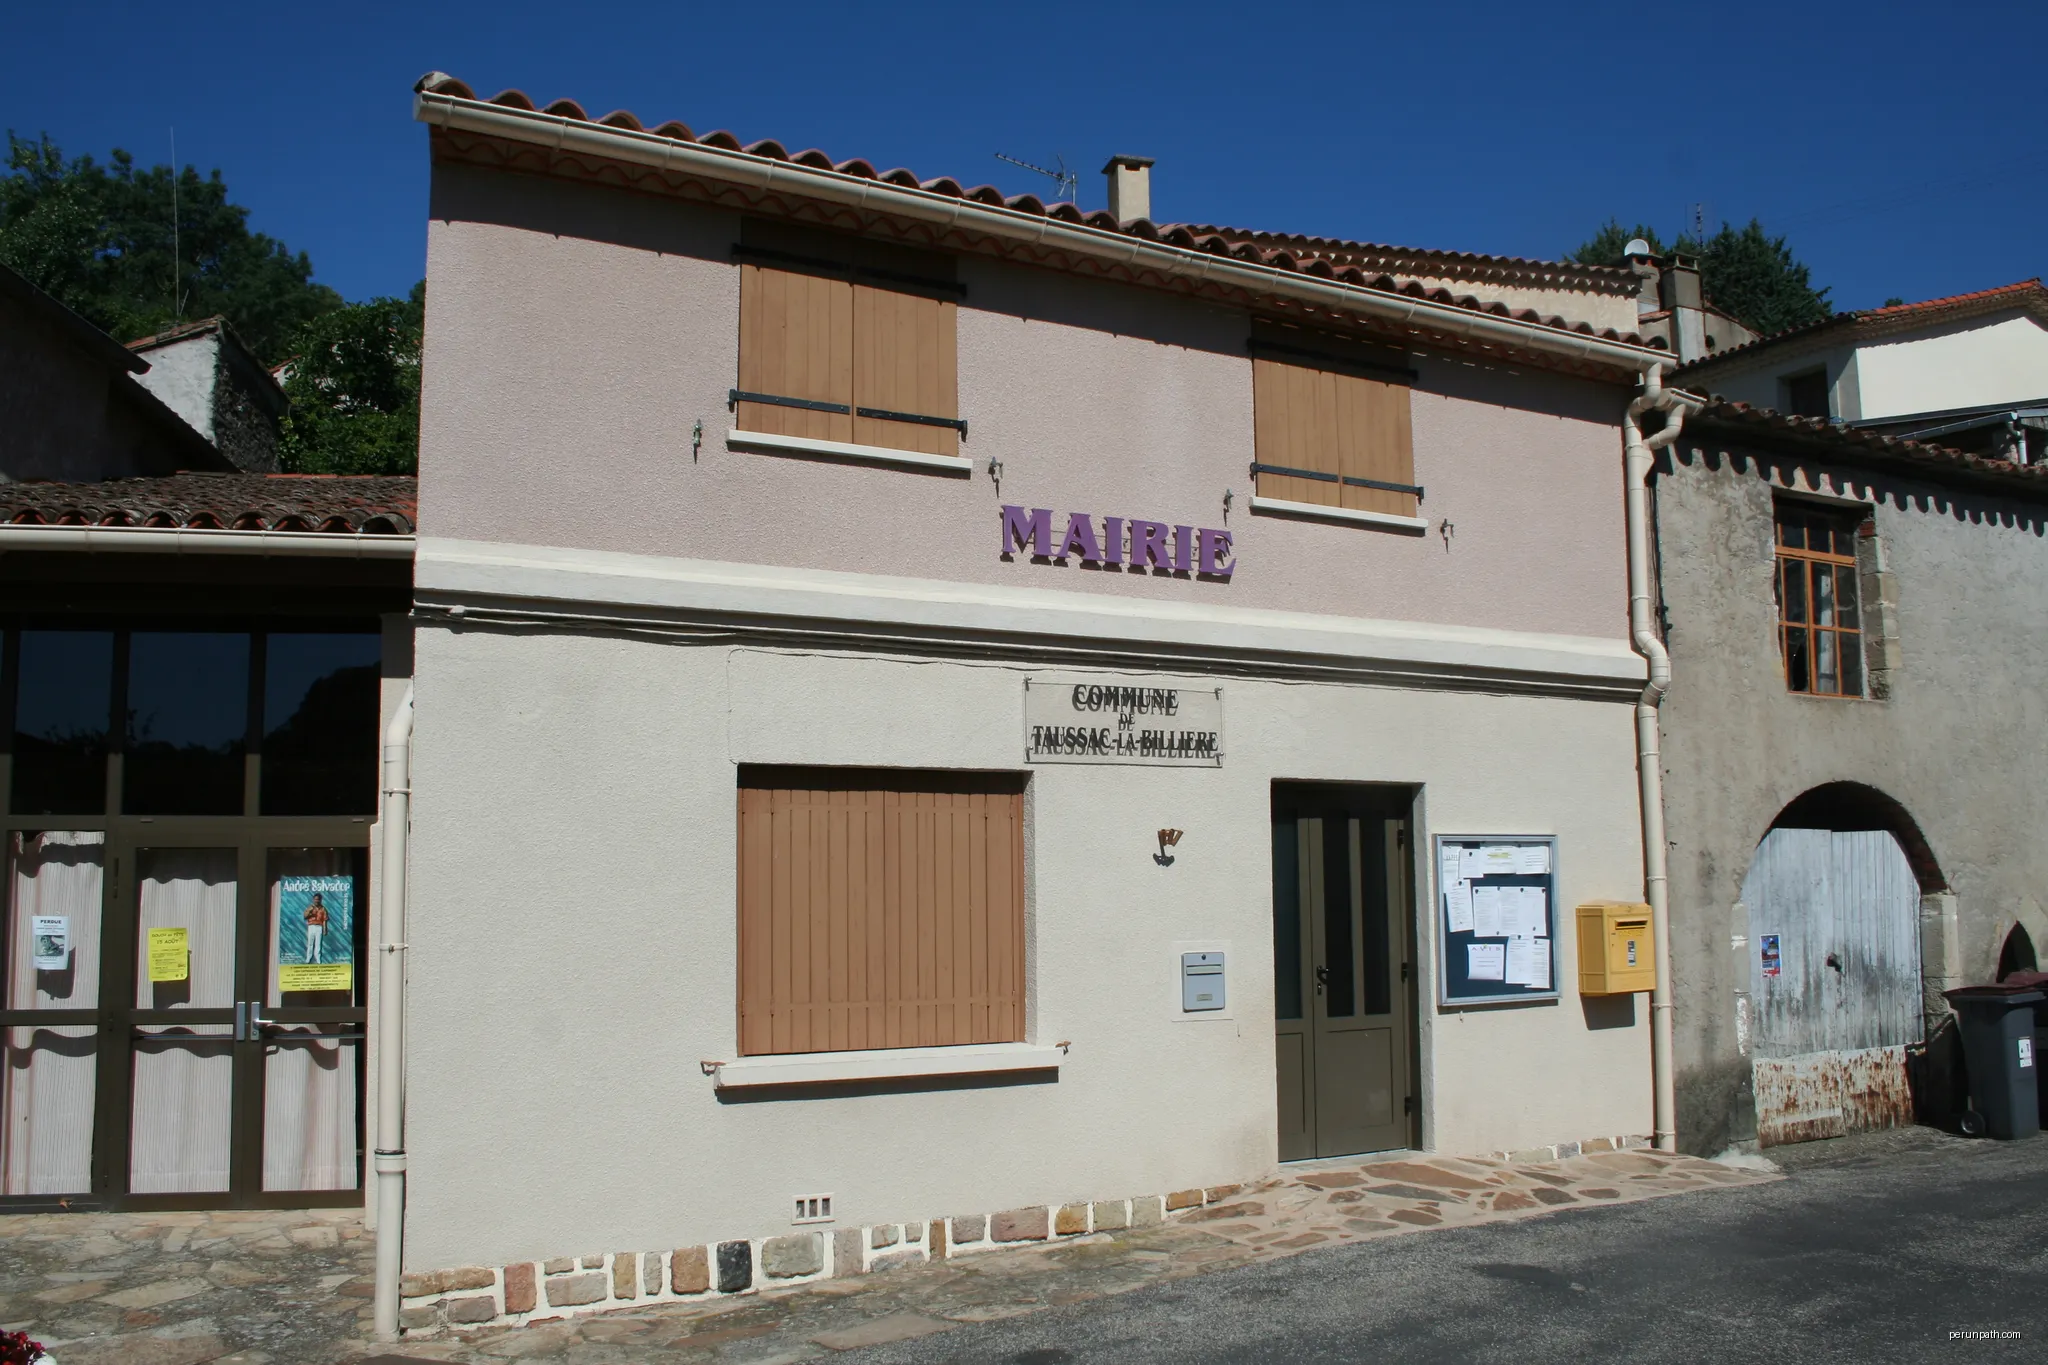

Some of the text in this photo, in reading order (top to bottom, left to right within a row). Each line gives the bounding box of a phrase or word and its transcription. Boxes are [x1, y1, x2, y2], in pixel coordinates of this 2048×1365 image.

[1001, 505, 1237, 576] MAIRIE
[1074, 684, 1179, 710] COMMUNE
[1119, 713, 1136, 726] DE
[1033, 726, 1219, 752] TAUSSAC-LA-BILLIERE
[283, 880, 350, 892] André Salvador
